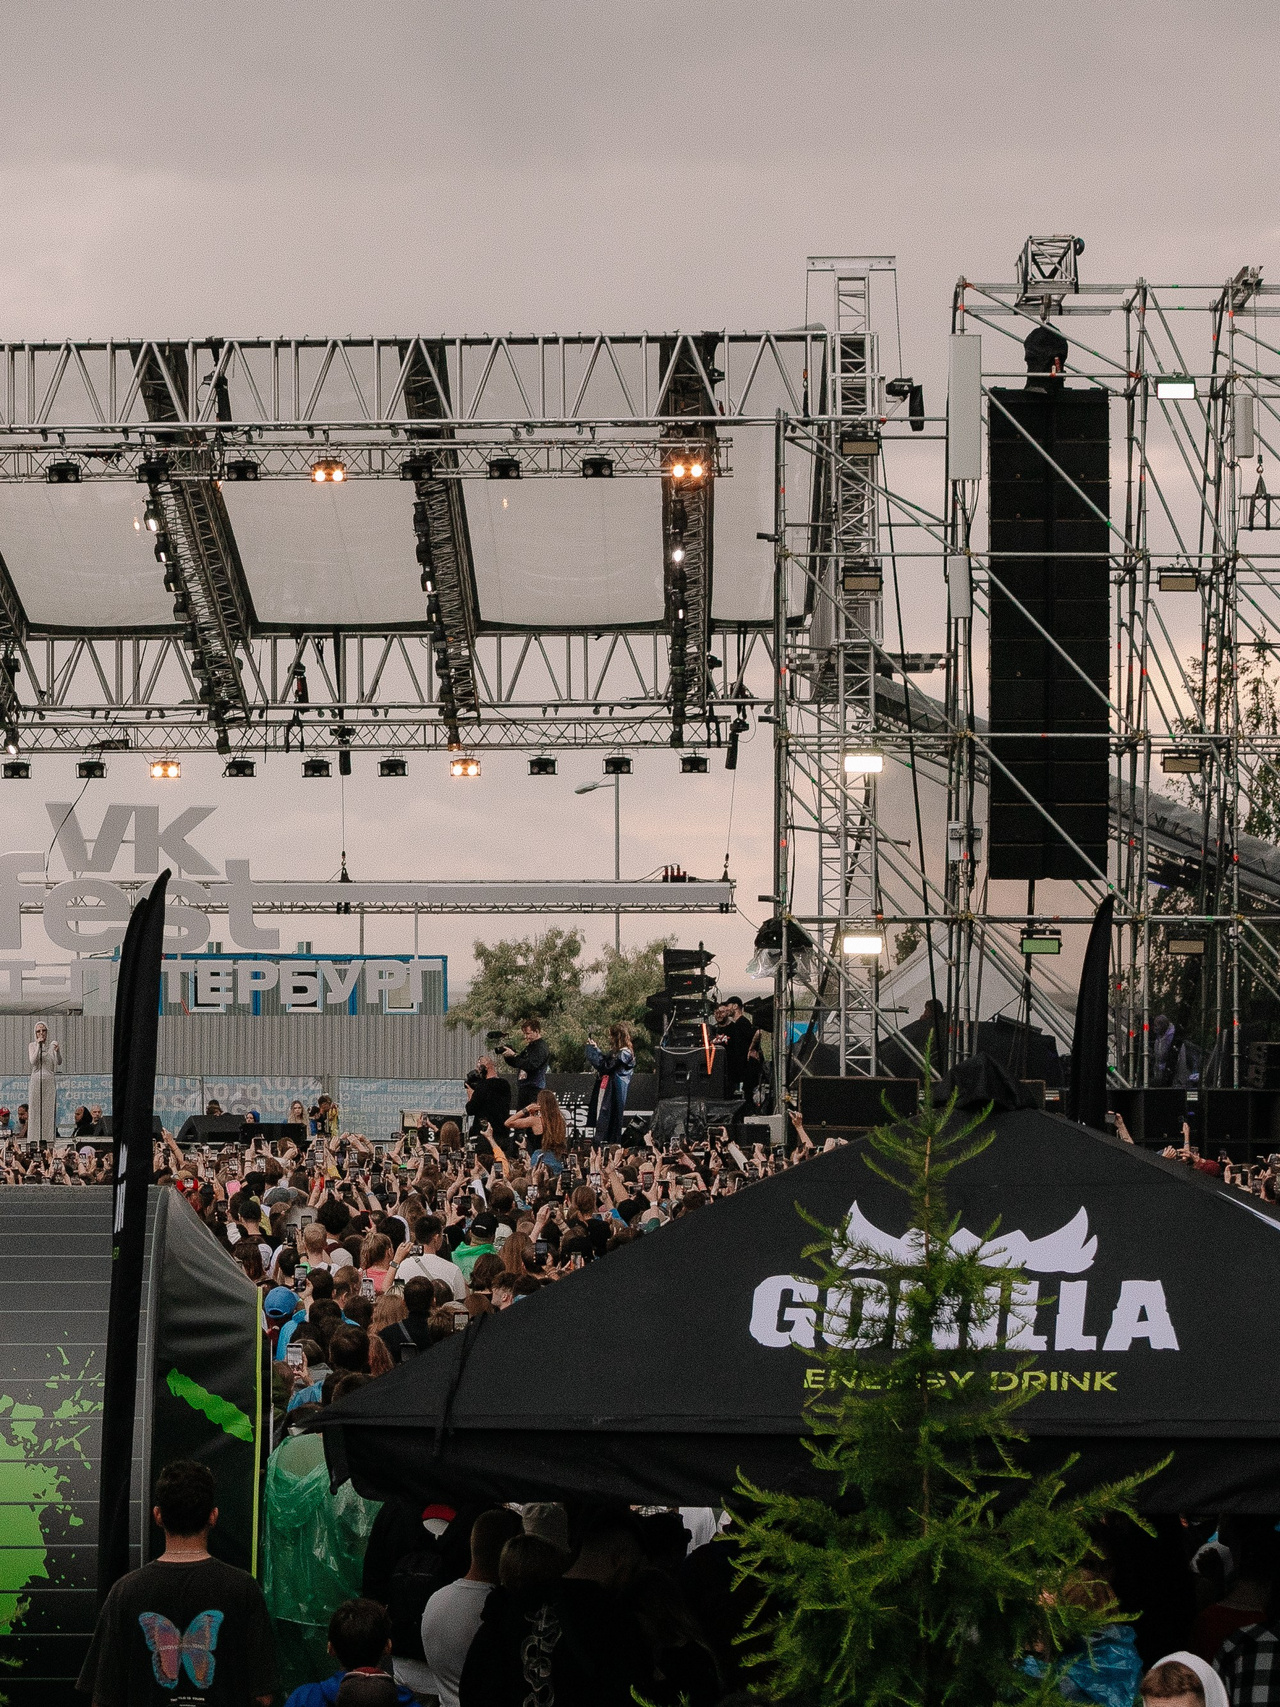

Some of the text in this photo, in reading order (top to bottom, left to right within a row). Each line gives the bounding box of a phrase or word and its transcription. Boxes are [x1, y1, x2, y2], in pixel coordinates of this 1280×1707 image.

[45, 802, 220, 876] VK
[803, 1368, 1118, 1392] ENGY DRINK
